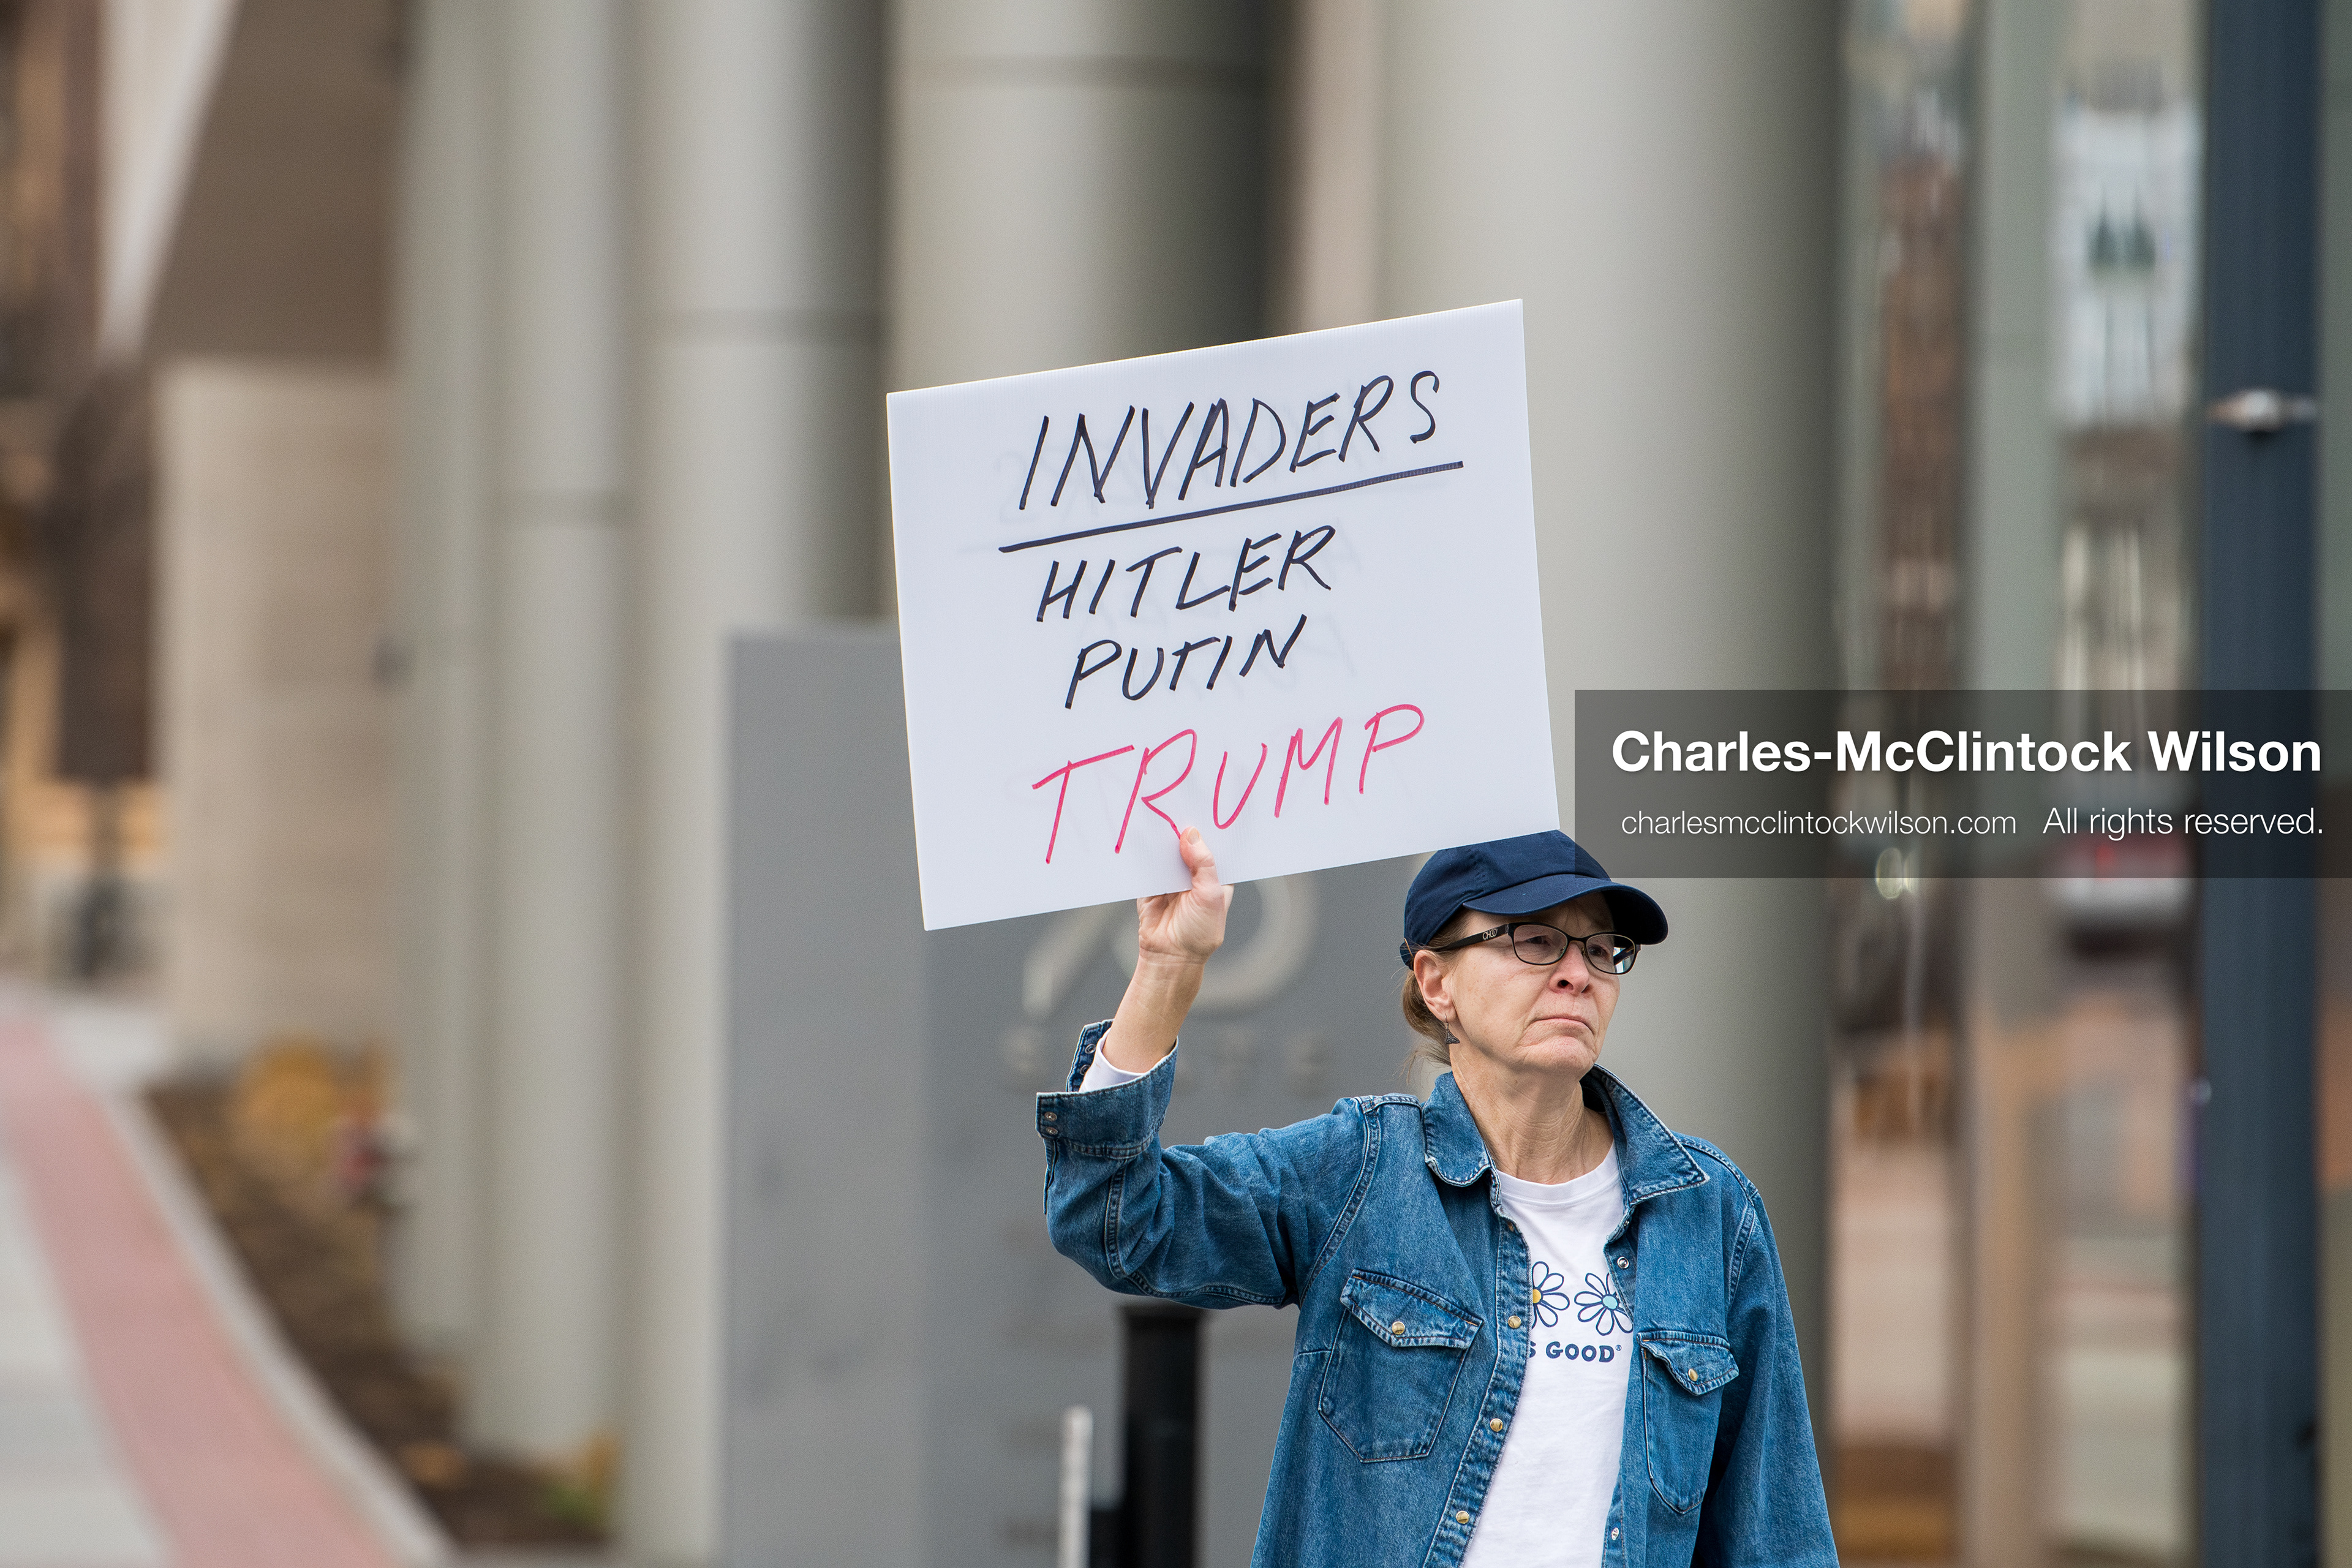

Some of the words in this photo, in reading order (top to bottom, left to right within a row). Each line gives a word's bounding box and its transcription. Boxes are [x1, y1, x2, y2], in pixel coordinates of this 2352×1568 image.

[1018, 369, 1441, 511] INVADERS
[1036, 524, 1336, 623] HITLER
[1064, 613, 1308, 710] PUTIN
[1031, 703, 1425, 865] TRUMP
